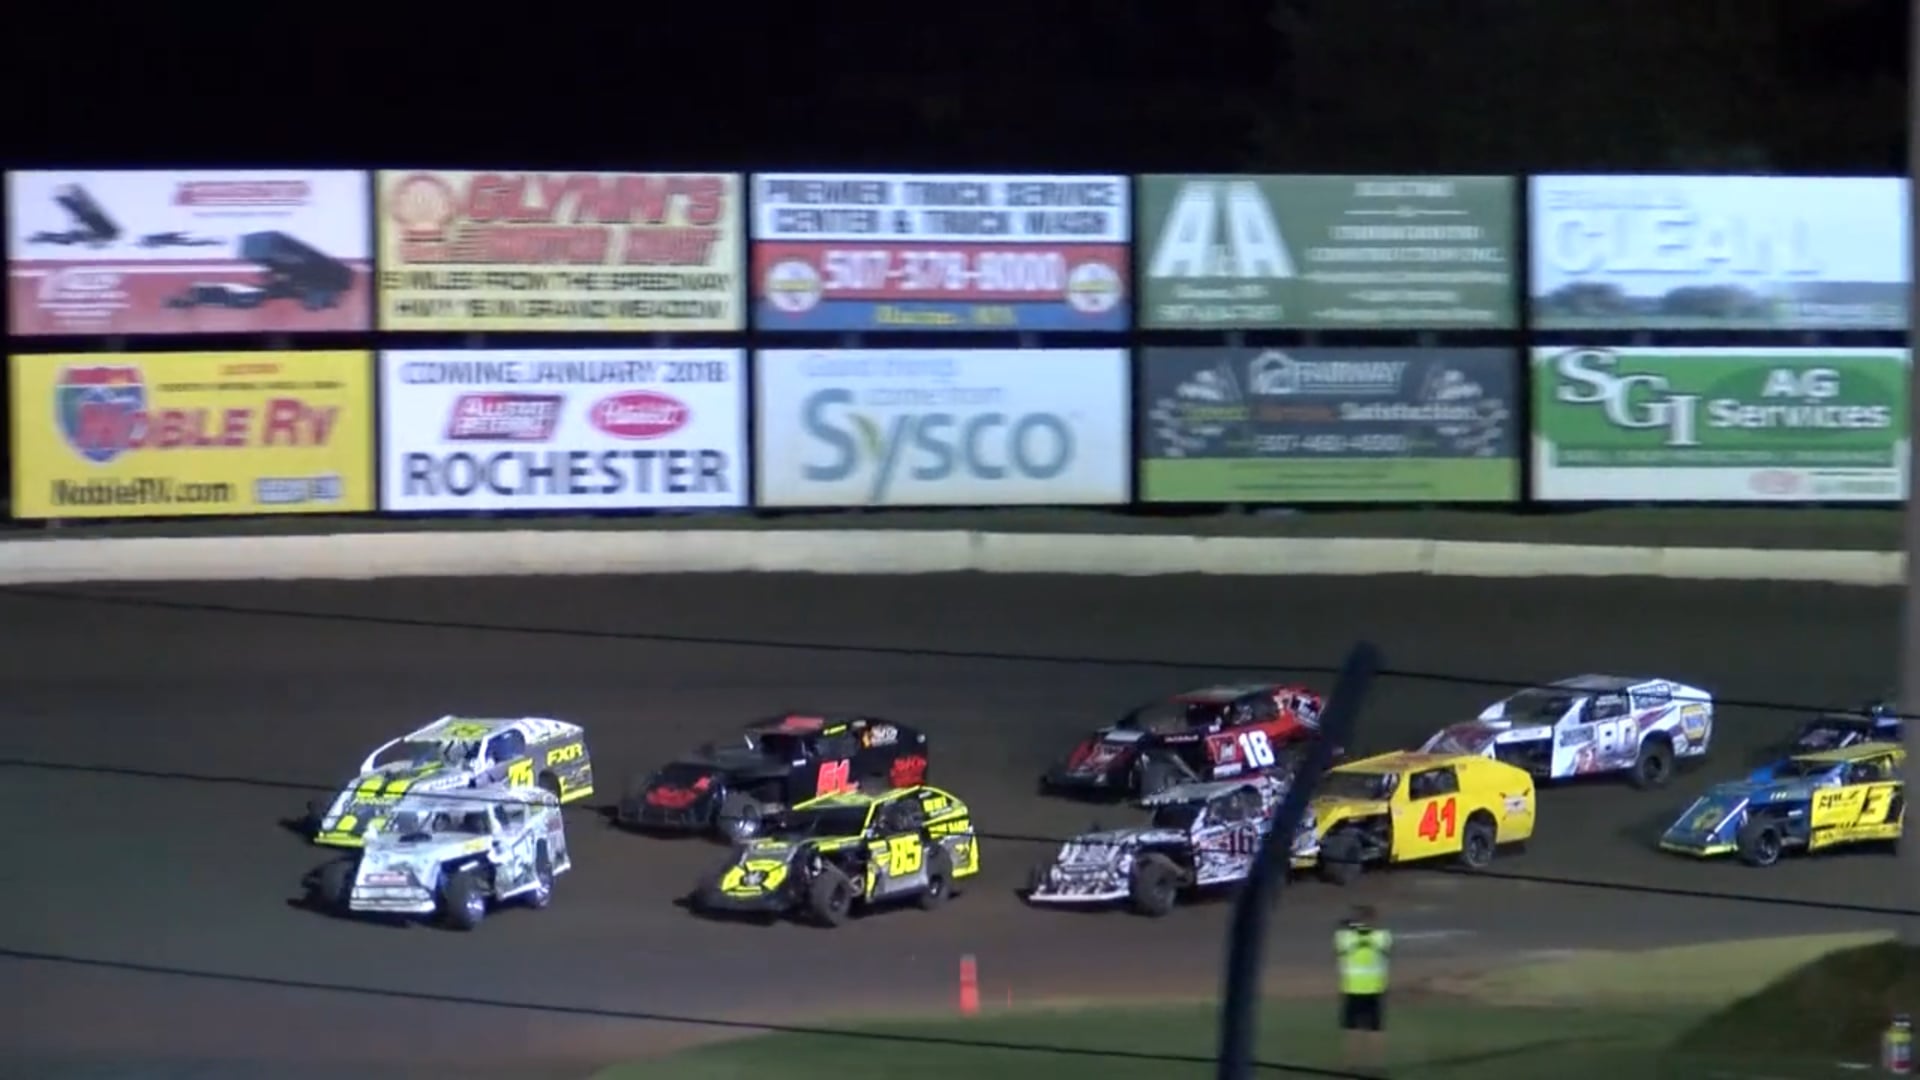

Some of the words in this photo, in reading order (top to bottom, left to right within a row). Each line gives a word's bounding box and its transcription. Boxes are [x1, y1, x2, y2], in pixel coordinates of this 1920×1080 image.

[905, 181, 993, 206] TRUCK
[1002, 182, 1116, 207] SERVICE
[775, 208, 882, 233] CENTER
[922, 210, 1010, 234] TRUCK
[1553, 213, 1824, 275] CLEAN
[480, 271, 549, 291] FROM
[606, 272, 732, 292] SPEEDWAY
[402, 361, 520, 384] COMING
[529, 361, 653, 384] JANUARY
[1762, 369, 1841, 398] AG
[1556, 349, 1701, 446] SGI
[78, 401, 252, 449] NOBLE
[1707, 398, 1891, 429] Services
[403, 450, 729, 496] ROCHESTER
[52, 477, 235, 506] NobleRV.com
[547, 743, 583, 767] FXR
[1238, 730, 1275, 769] 18
[1417, 798, 1456, 842] 41
[889, 831, 923, 877] 85
